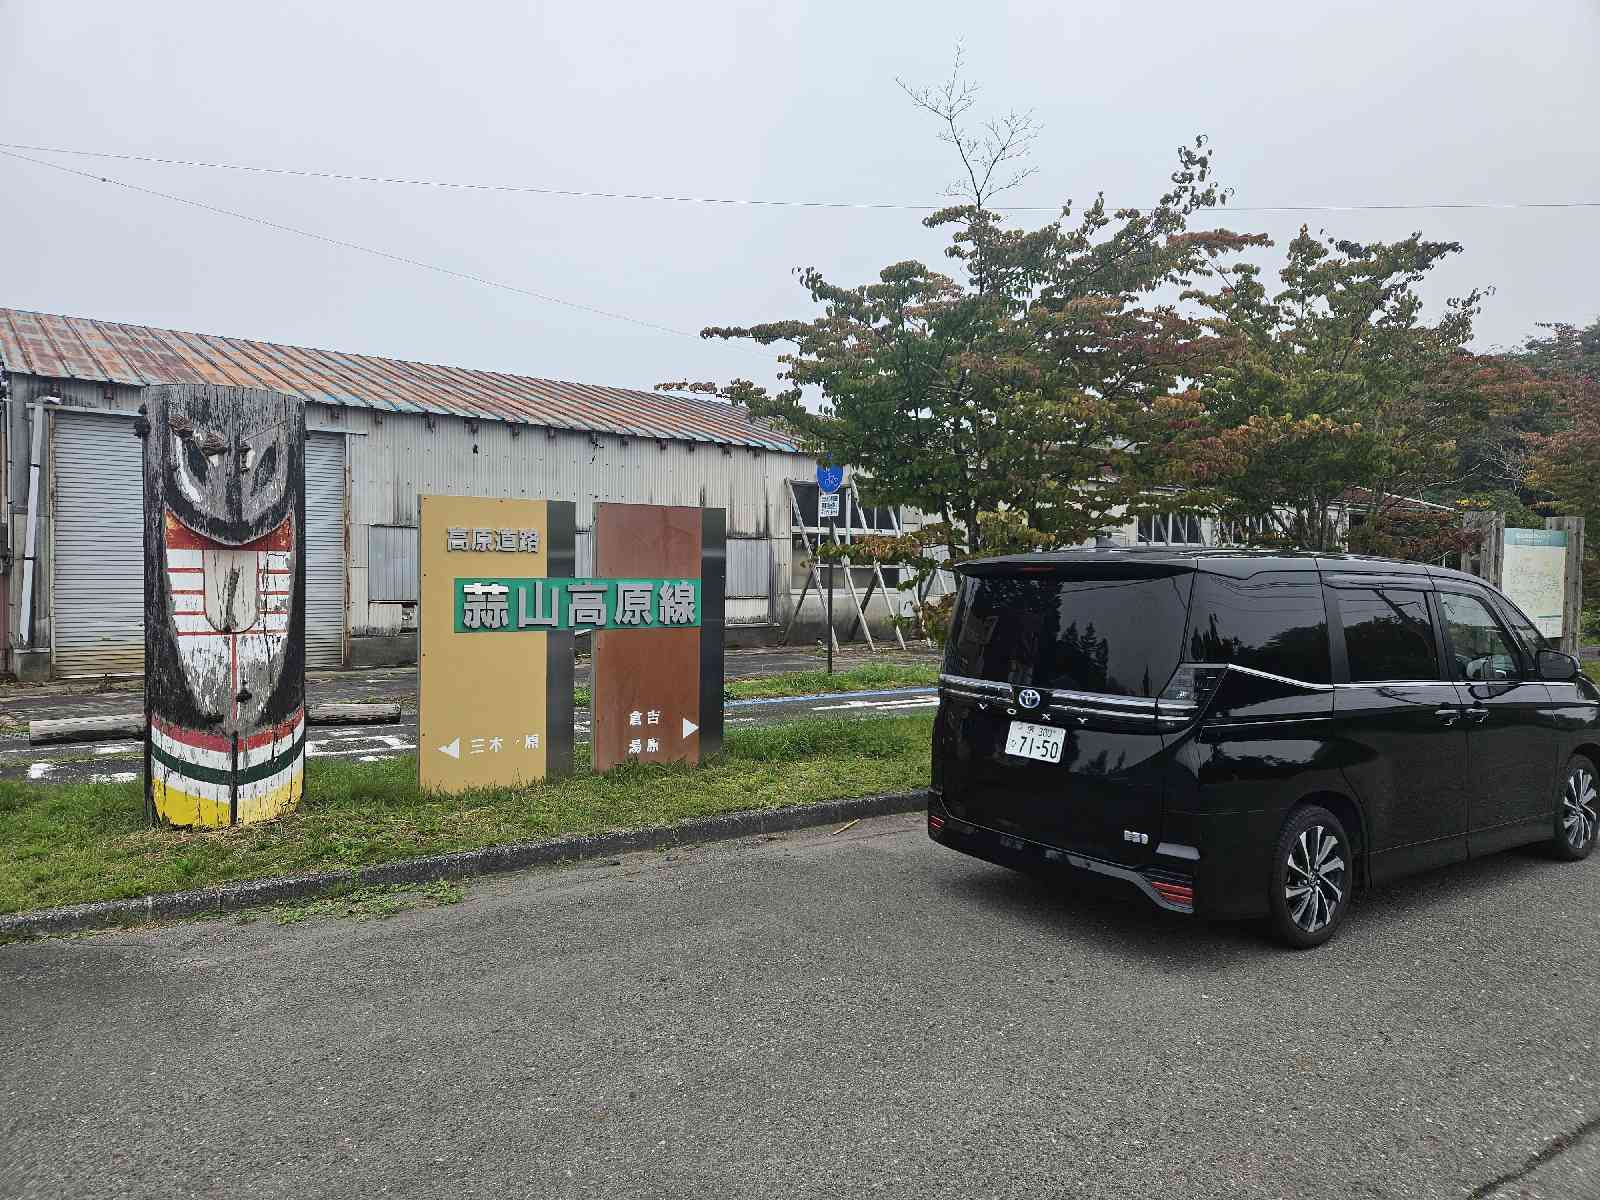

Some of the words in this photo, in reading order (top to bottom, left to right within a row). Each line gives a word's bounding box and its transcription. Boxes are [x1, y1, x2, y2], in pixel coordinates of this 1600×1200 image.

[447, 527, 539, 553] 高原道路
[463, 580, 697, 629] 蒜山高原線
[1019, 735, 1059, 759] 71-50
